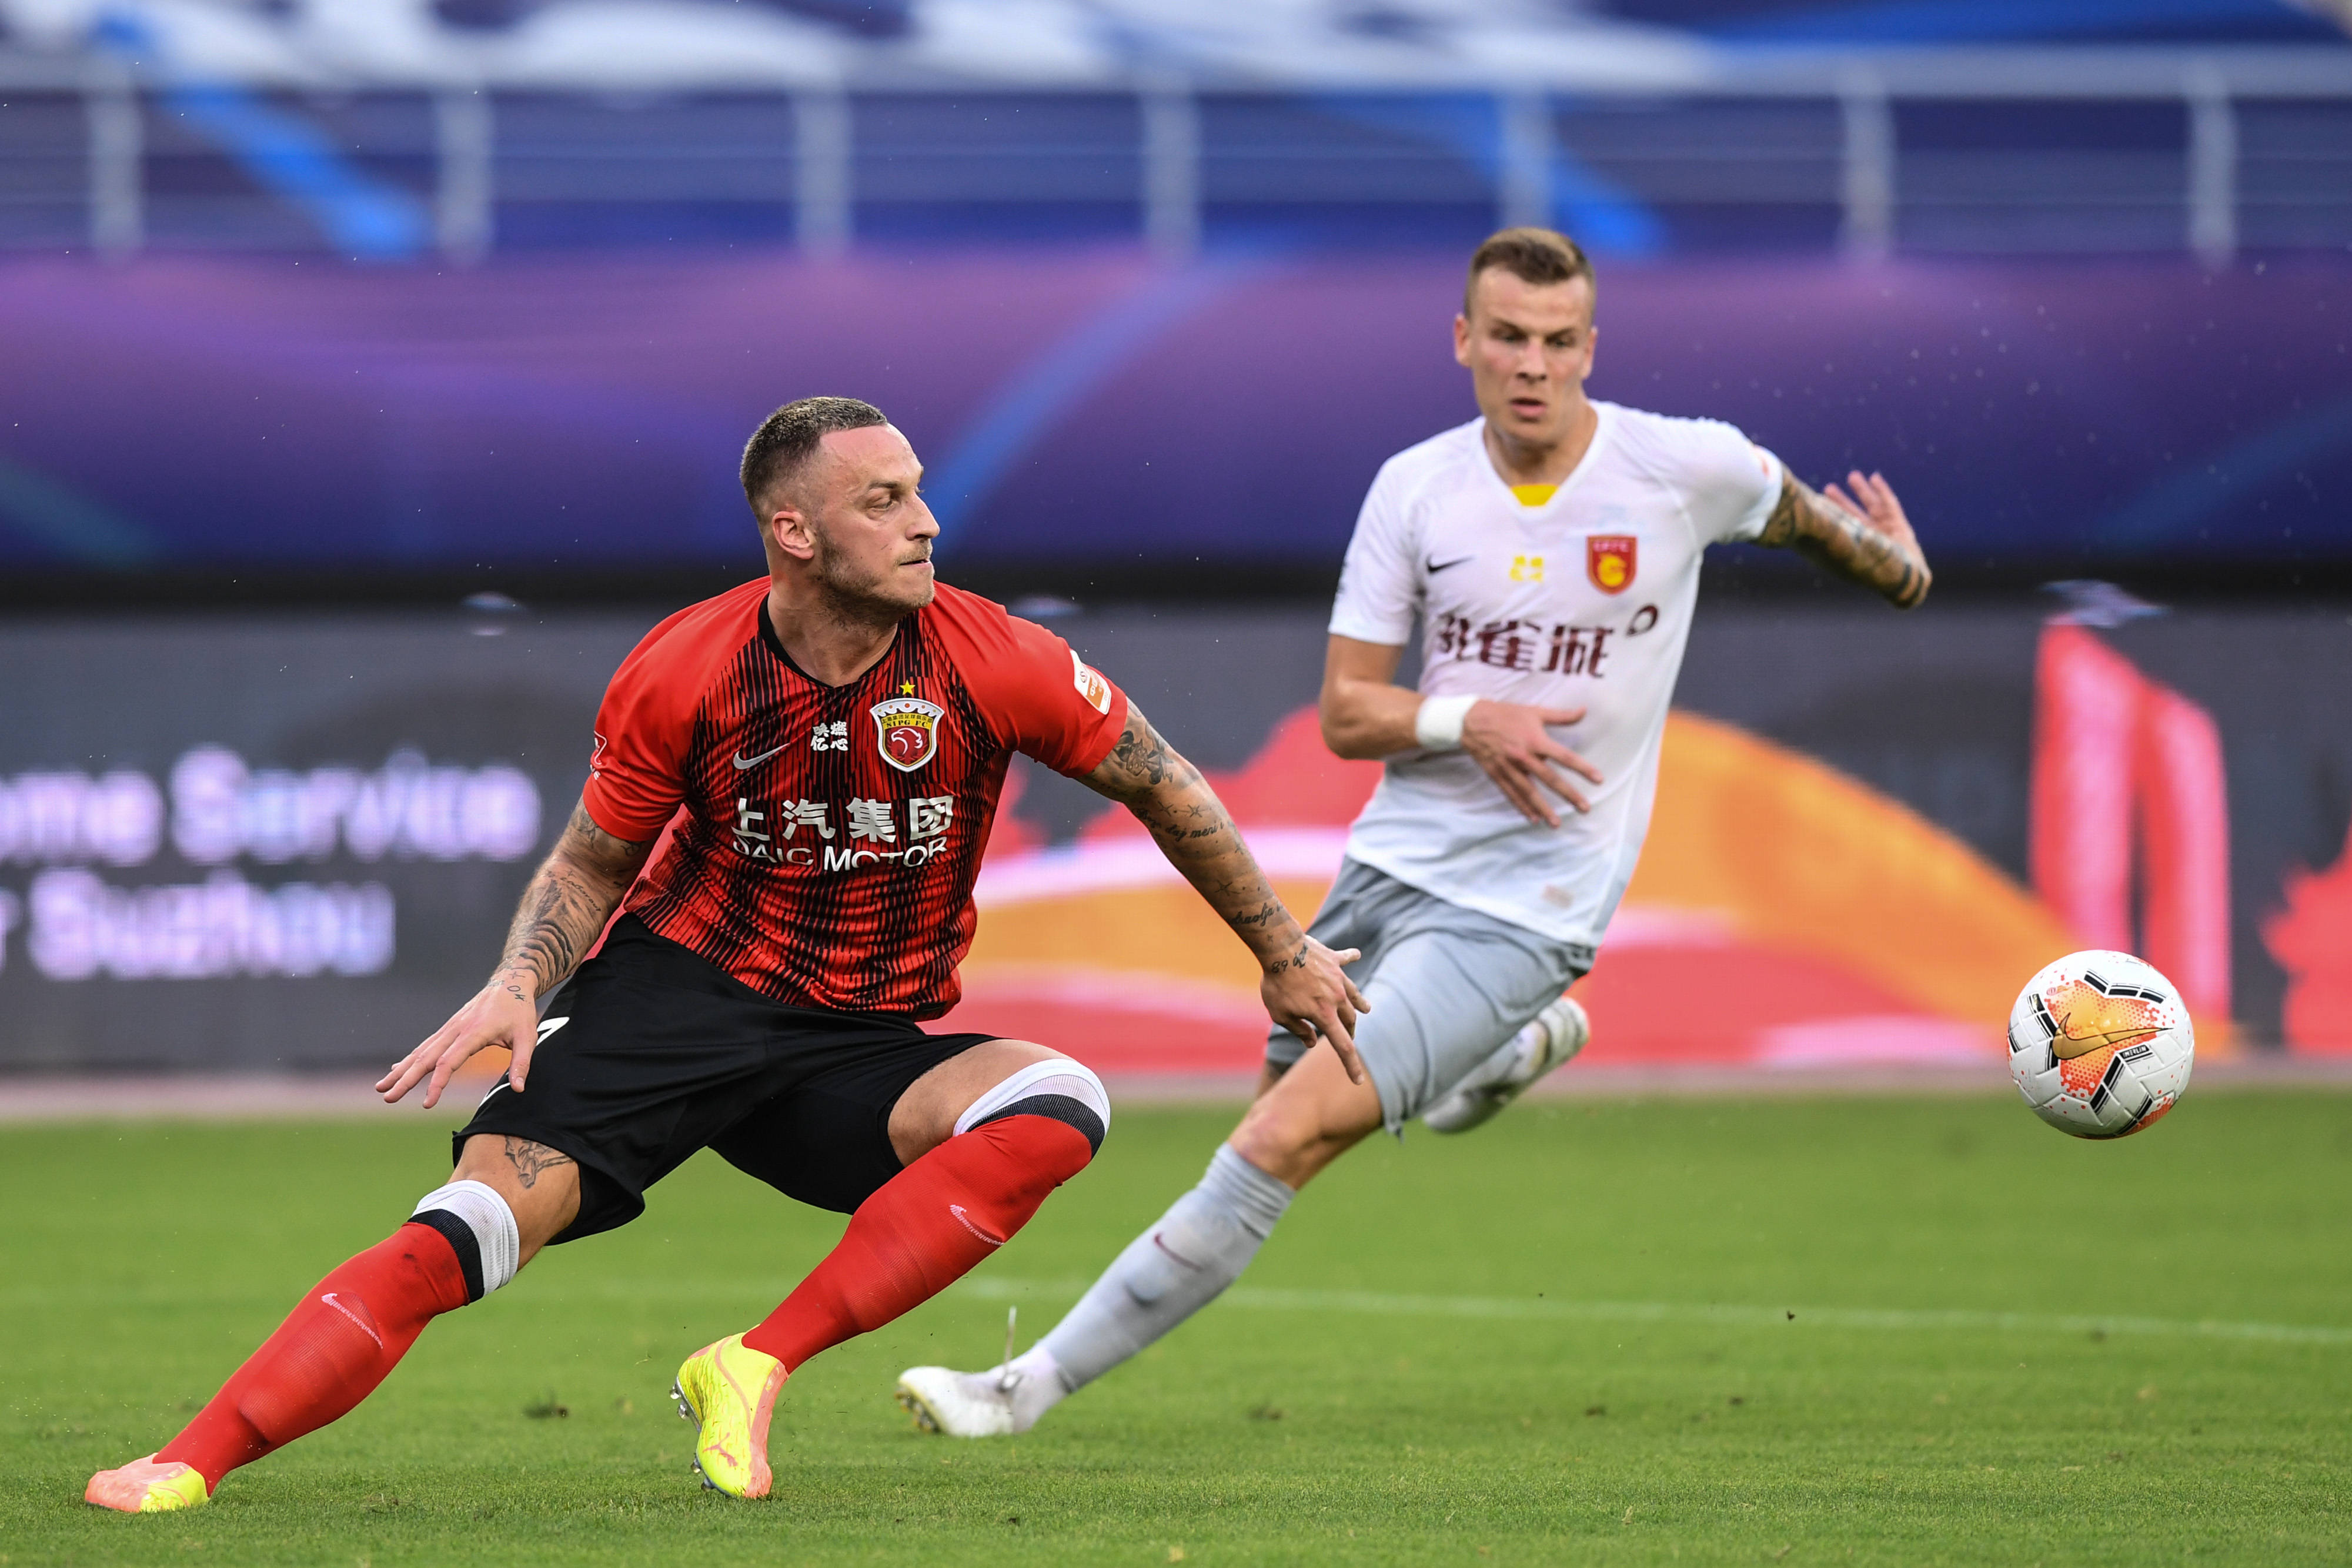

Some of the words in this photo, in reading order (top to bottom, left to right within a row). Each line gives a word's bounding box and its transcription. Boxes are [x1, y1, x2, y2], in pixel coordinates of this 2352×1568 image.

[887, 720, 911, 728] SIPG
[170, 741, 542, 864] Service
[731, 795, 954, 843] 上汽集团
[823, 836, 947, 872] MOTOR
[28, 867, 396, 981] Suzhou
[1271, 959, 1288, 974] 89
